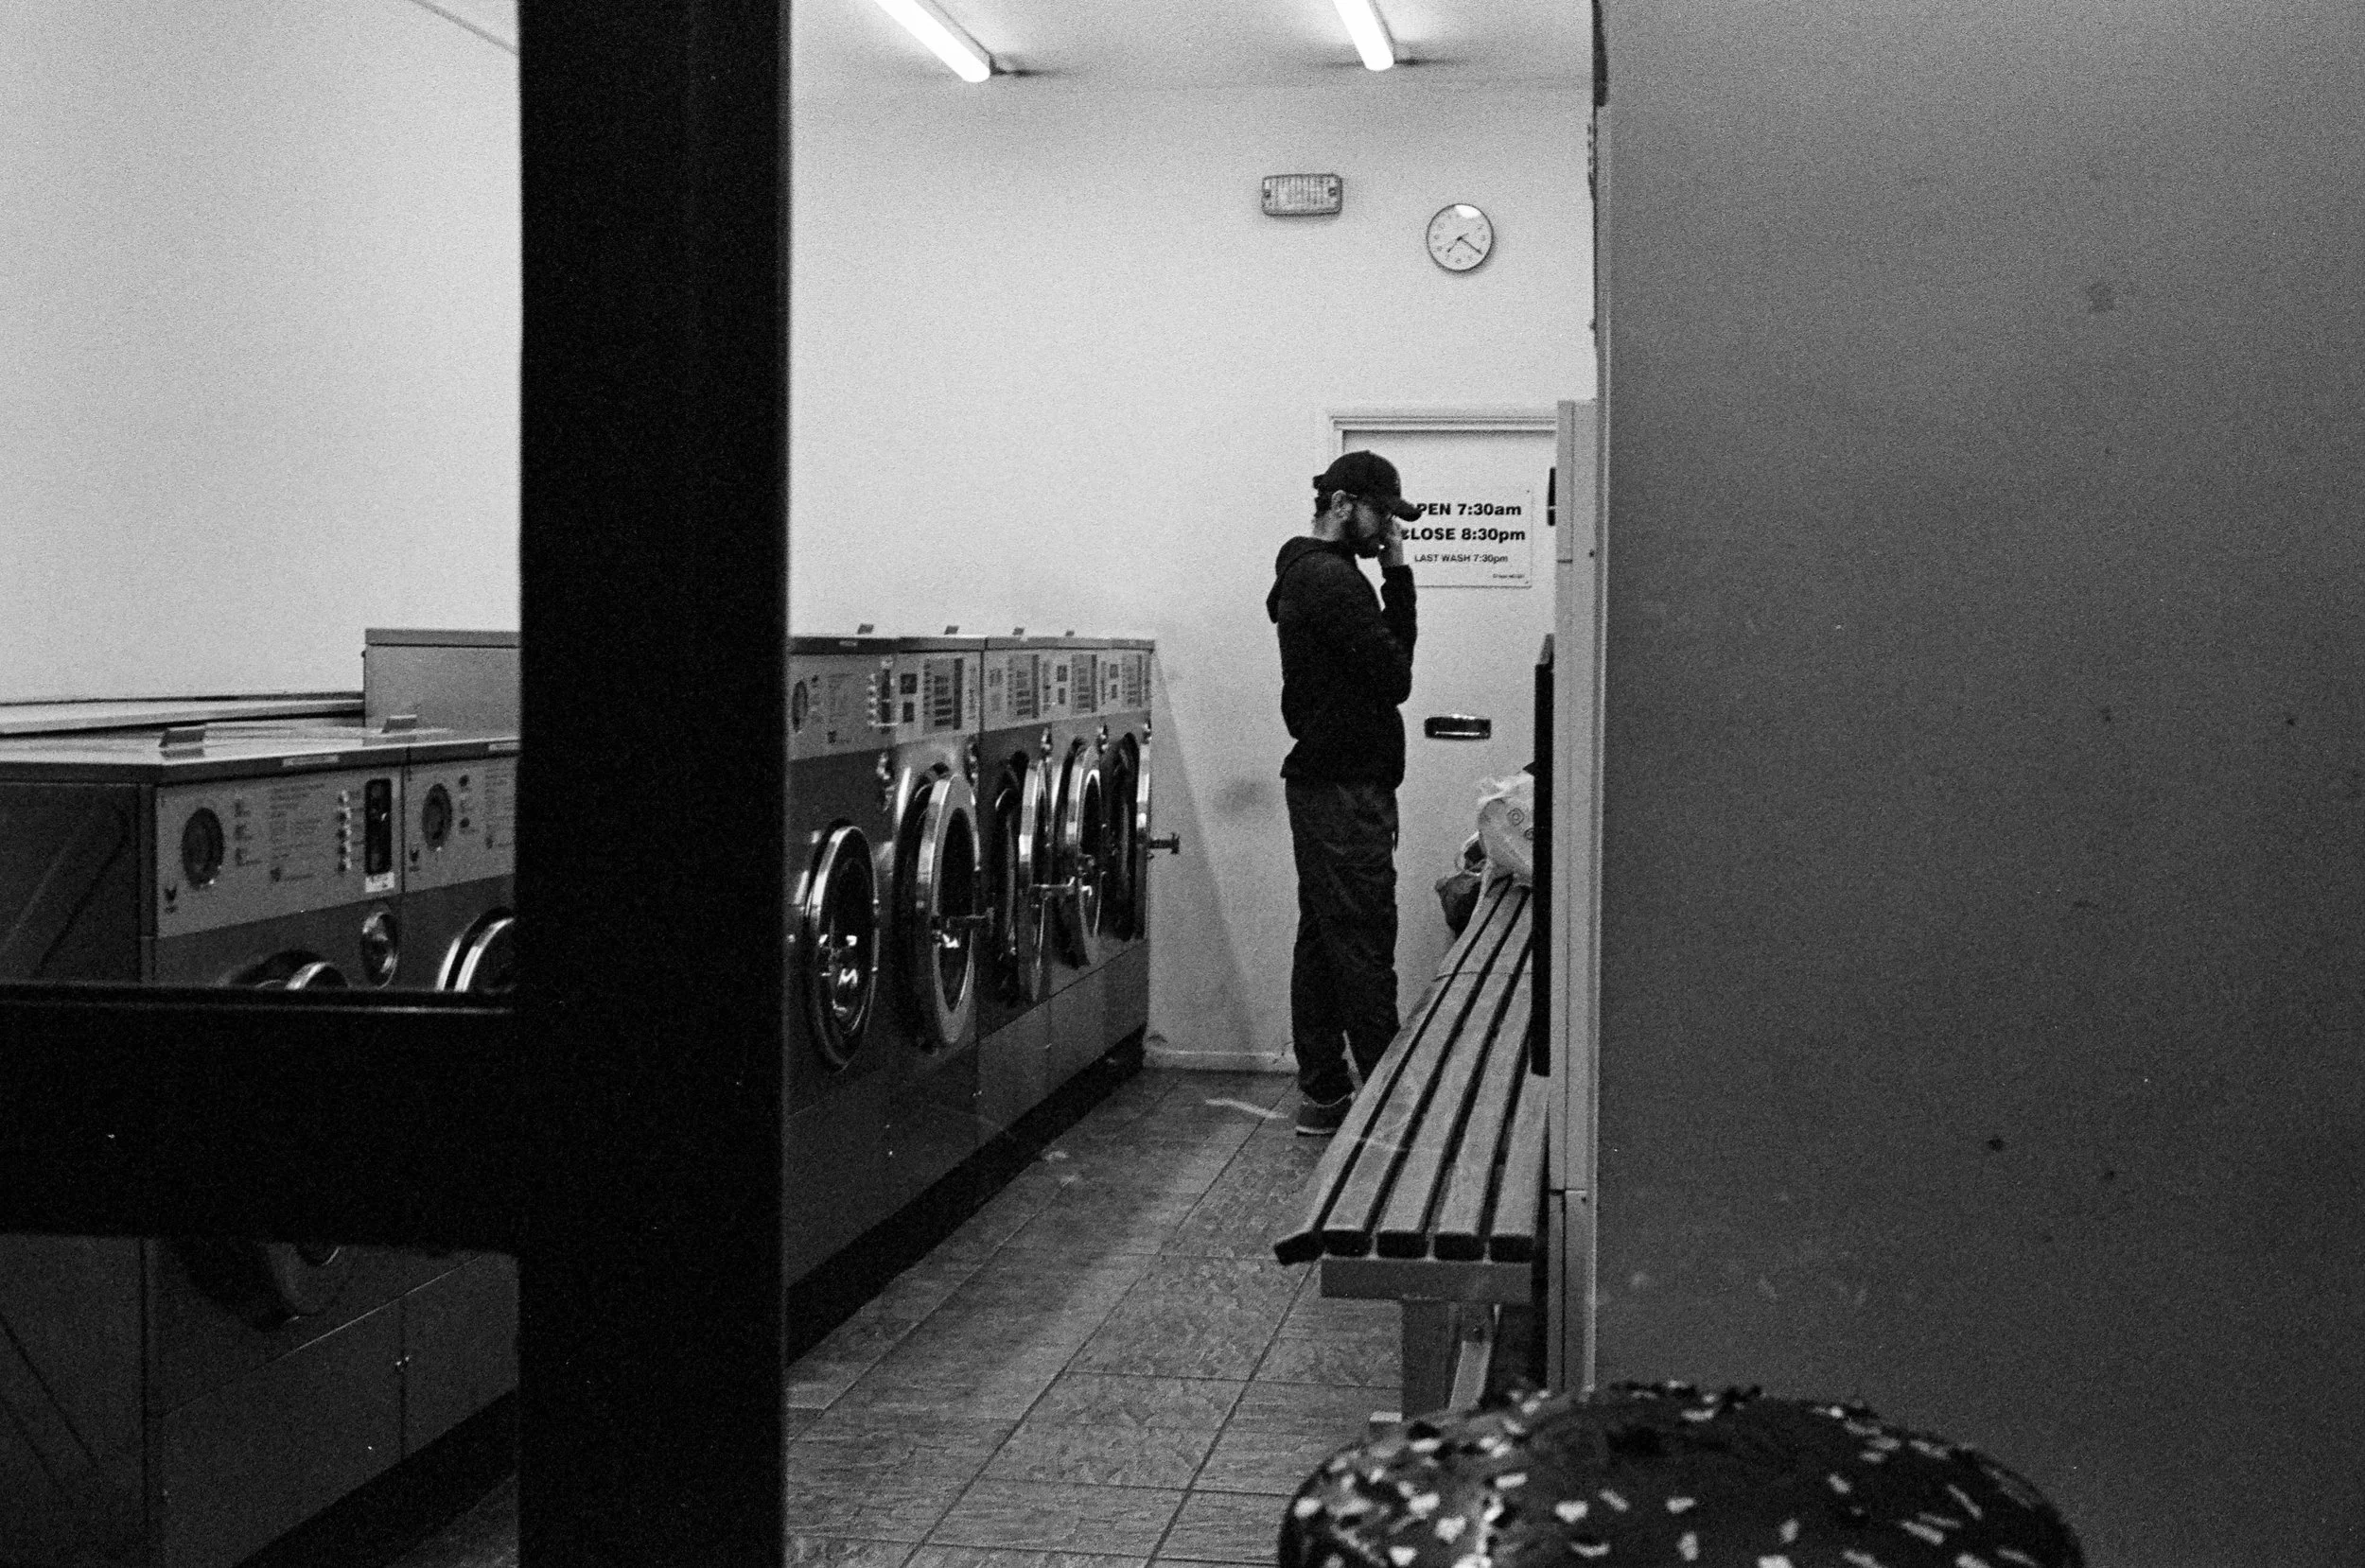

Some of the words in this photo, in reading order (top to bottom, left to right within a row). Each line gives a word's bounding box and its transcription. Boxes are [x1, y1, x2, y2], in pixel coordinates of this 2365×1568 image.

[1416, 503, 1451, 515] PEN
[1457, 503, 1522, 515] 7:30am
[1462, 528, 1526, 544] 8:30pm
[1414, 554, 1439, 563] LAST
[1442, 554, 1471, 563] WASH
[1473, 554, 1509, 564] 7:30pm
